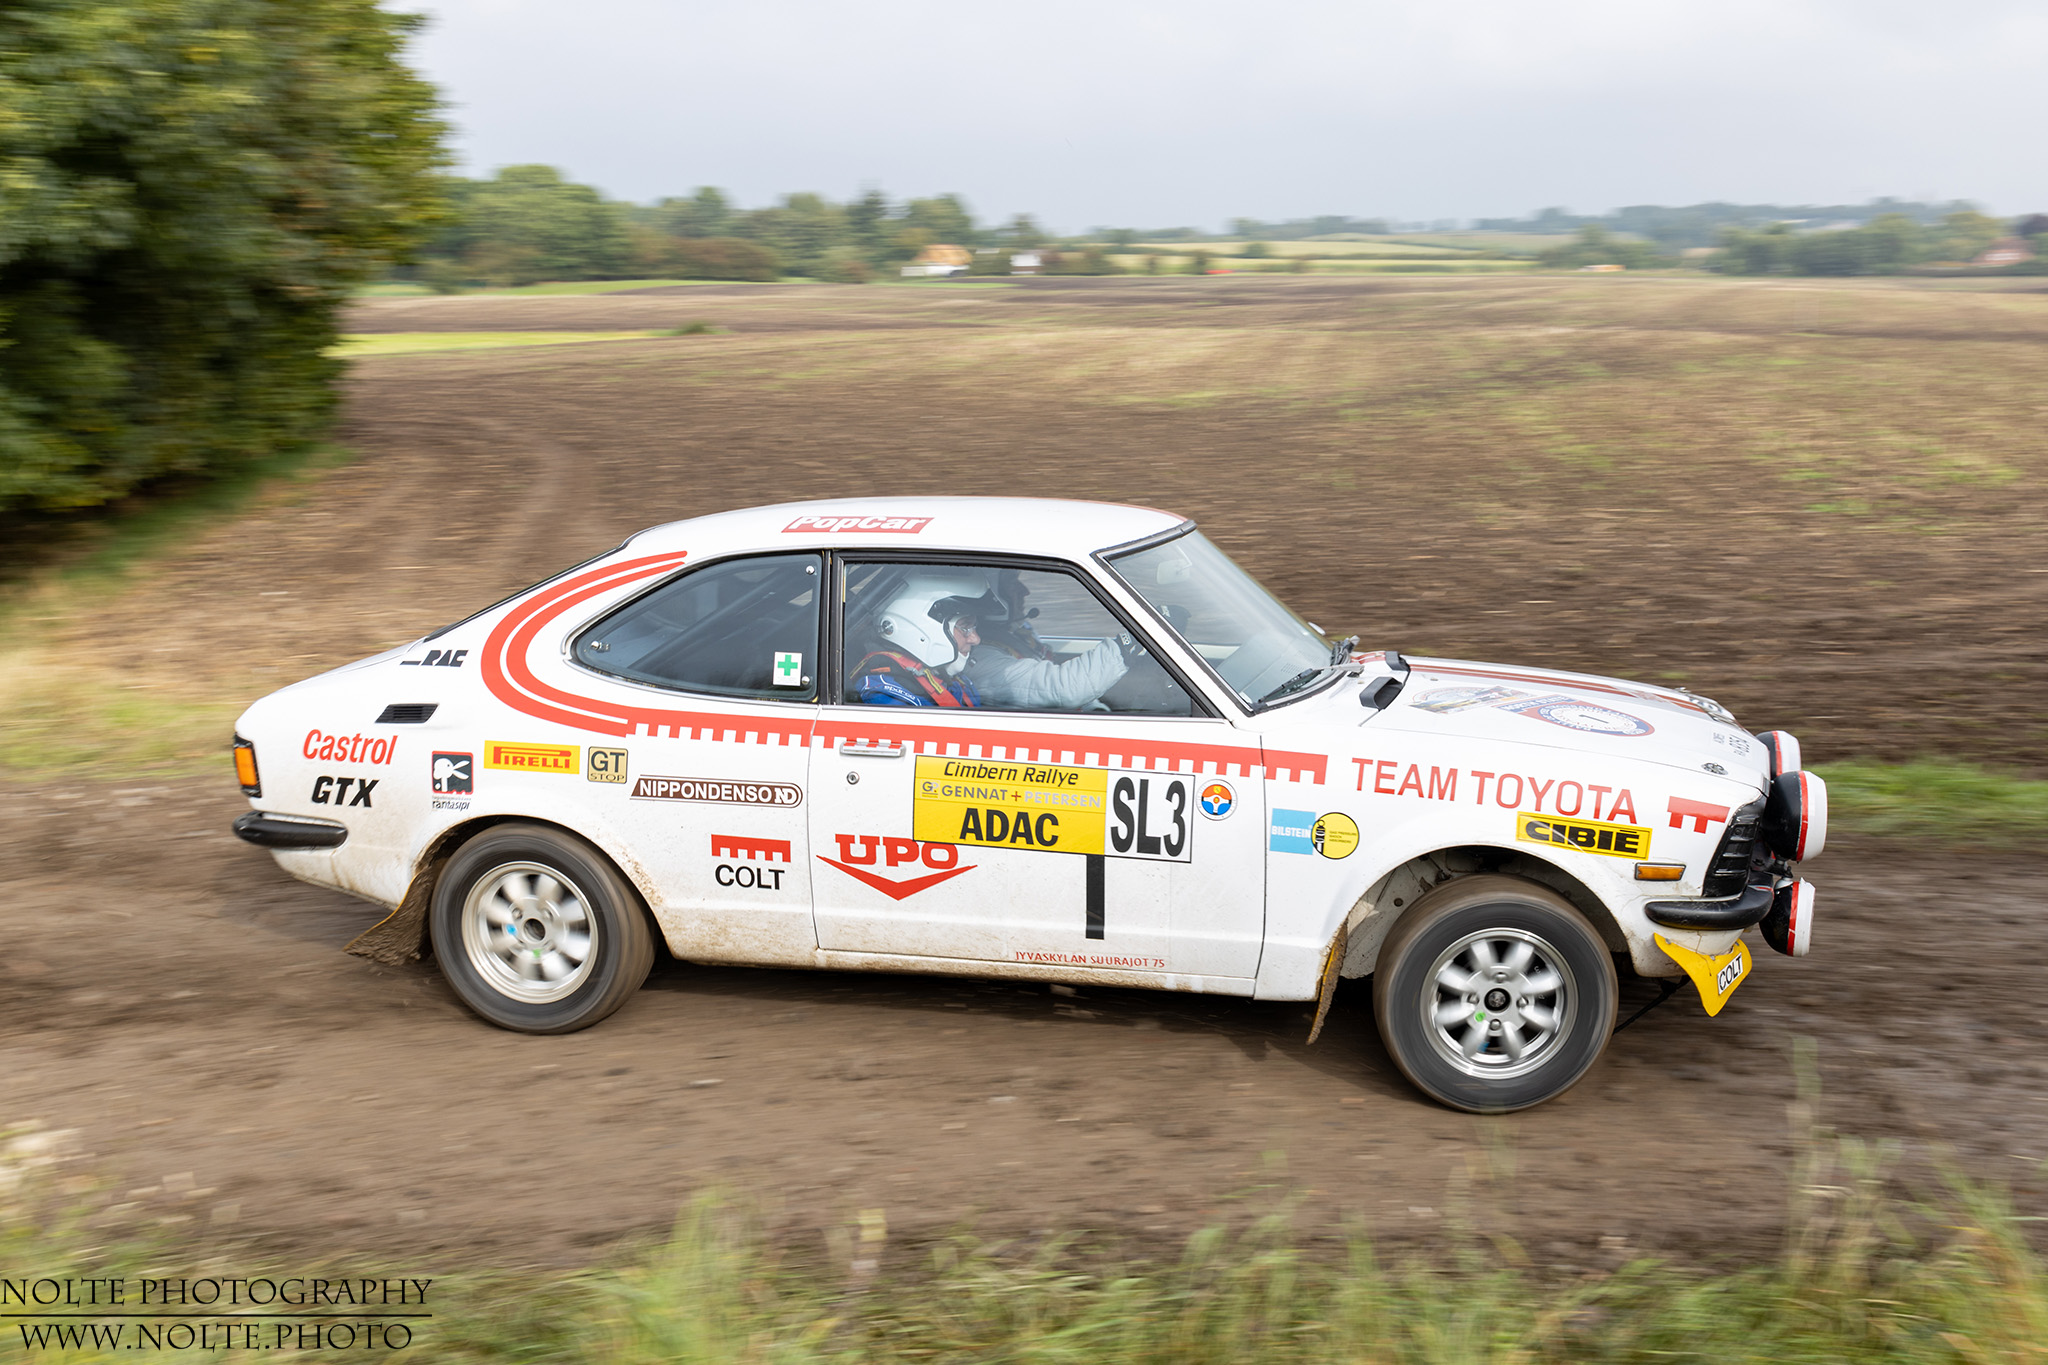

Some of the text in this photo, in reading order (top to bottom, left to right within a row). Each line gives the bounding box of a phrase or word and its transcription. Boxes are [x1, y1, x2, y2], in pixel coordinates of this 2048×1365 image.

[788, 516, 926, 533] PopCar
[303, 729, 398, 765] Castrol
[493, 746, 572, 769] PIRELLI
[591, 751, 625, 773] GT
[944, 761, 1079, 787] Cimbern Rallye
[591, 773, 624, 781] STOP
[312, 775, 379, 807] GTX
[639, 779, 772, 803] NIPPONDENSO
[942, 784, 1008, 801] GENNAT
[1024, 791, 1101, 808] PETERSEN
[1352, 757, 1637, 824] TEAM TOYOTA
[959, 807, 1059, 847] ADAC
[1110, 777, 1186, 857] SL3
[1271, 825, 1311, 838] BILSTEIN
[835, 834, 959, 869] UPO
[715, 864, 785, 890] COLT
[1090, 956, 1149, 967] SUURAJOT
[1152, 959, 1165, 968] 75
[1719, 954, 1742, 991] COLT
